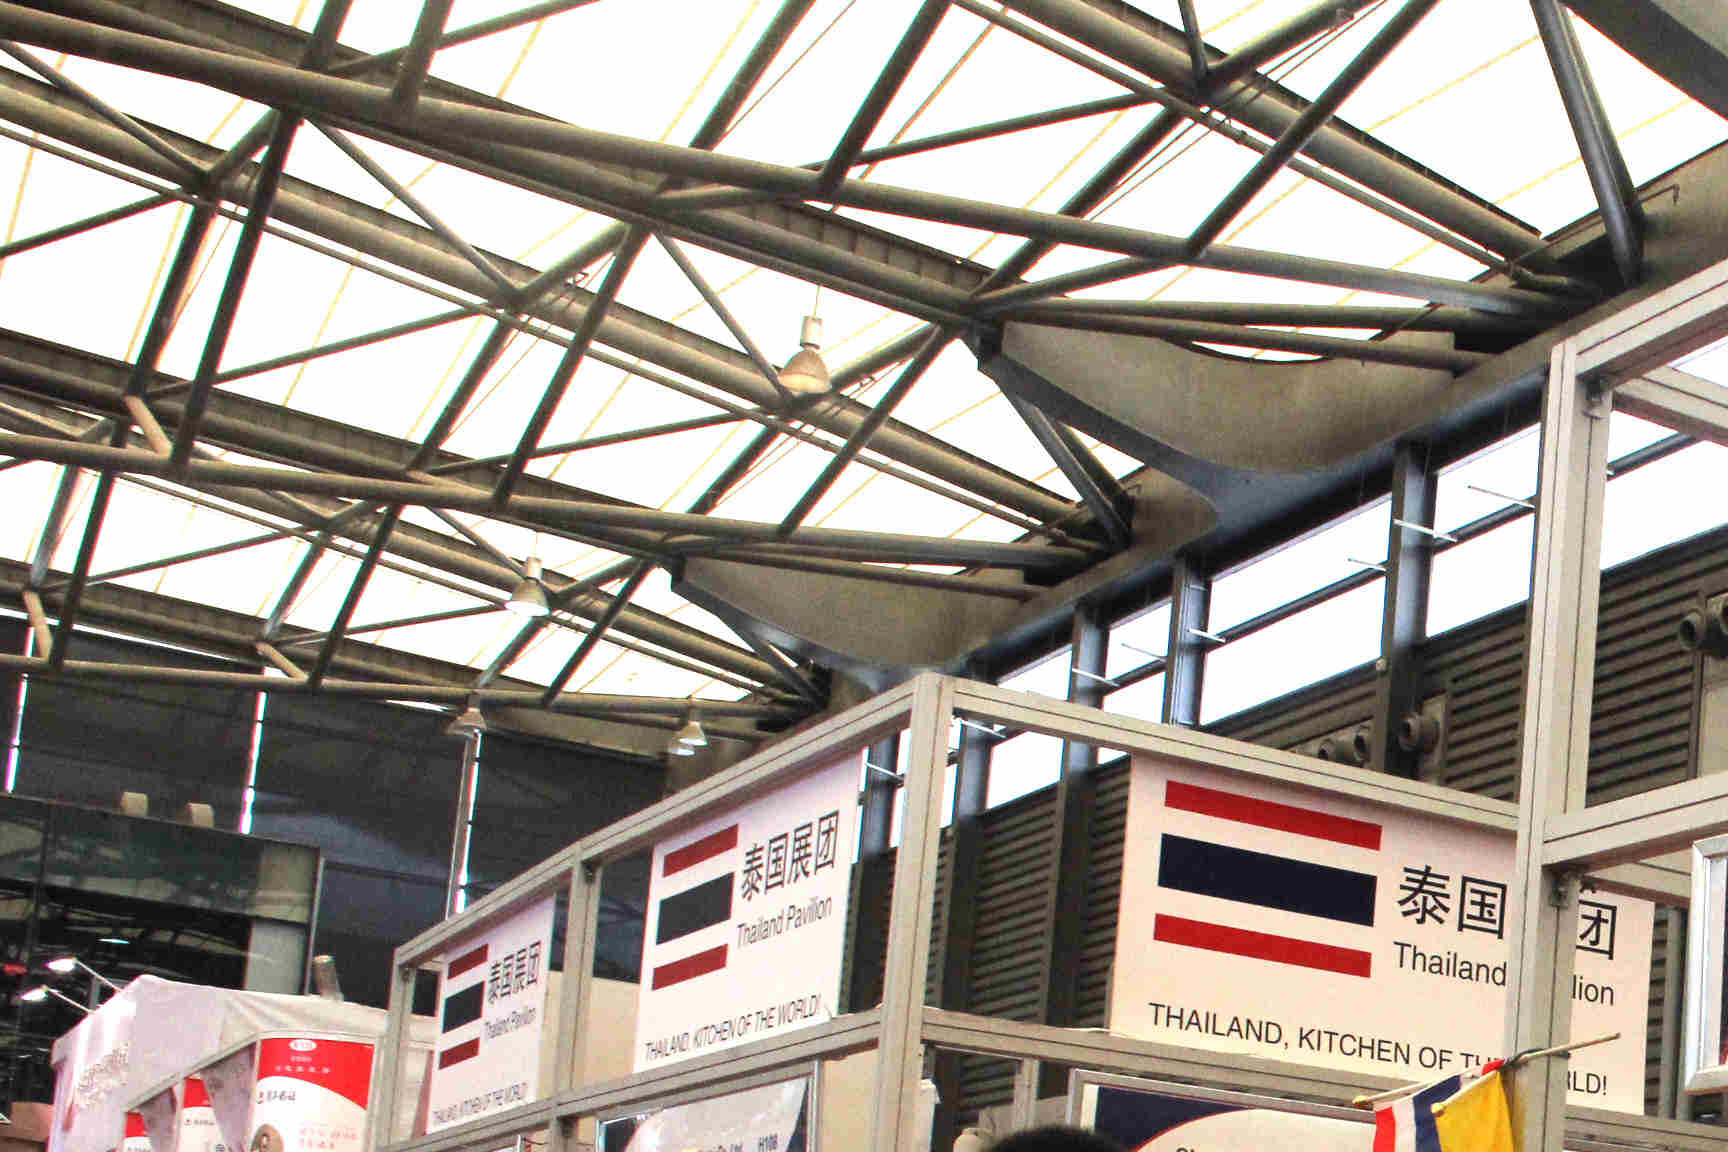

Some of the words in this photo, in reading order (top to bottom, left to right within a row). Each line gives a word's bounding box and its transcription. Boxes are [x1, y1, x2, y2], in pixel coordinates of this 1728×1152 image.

[742, 810, 839, 901] 泰国展团
[1393, 941, 1507, 987] Thailand
[1150, 1002, 1289, 1049] THAILAND,
[1299, 1027, 1411, 1065] KITCHEN
[1419, 1046, 1453, 1071] OF
